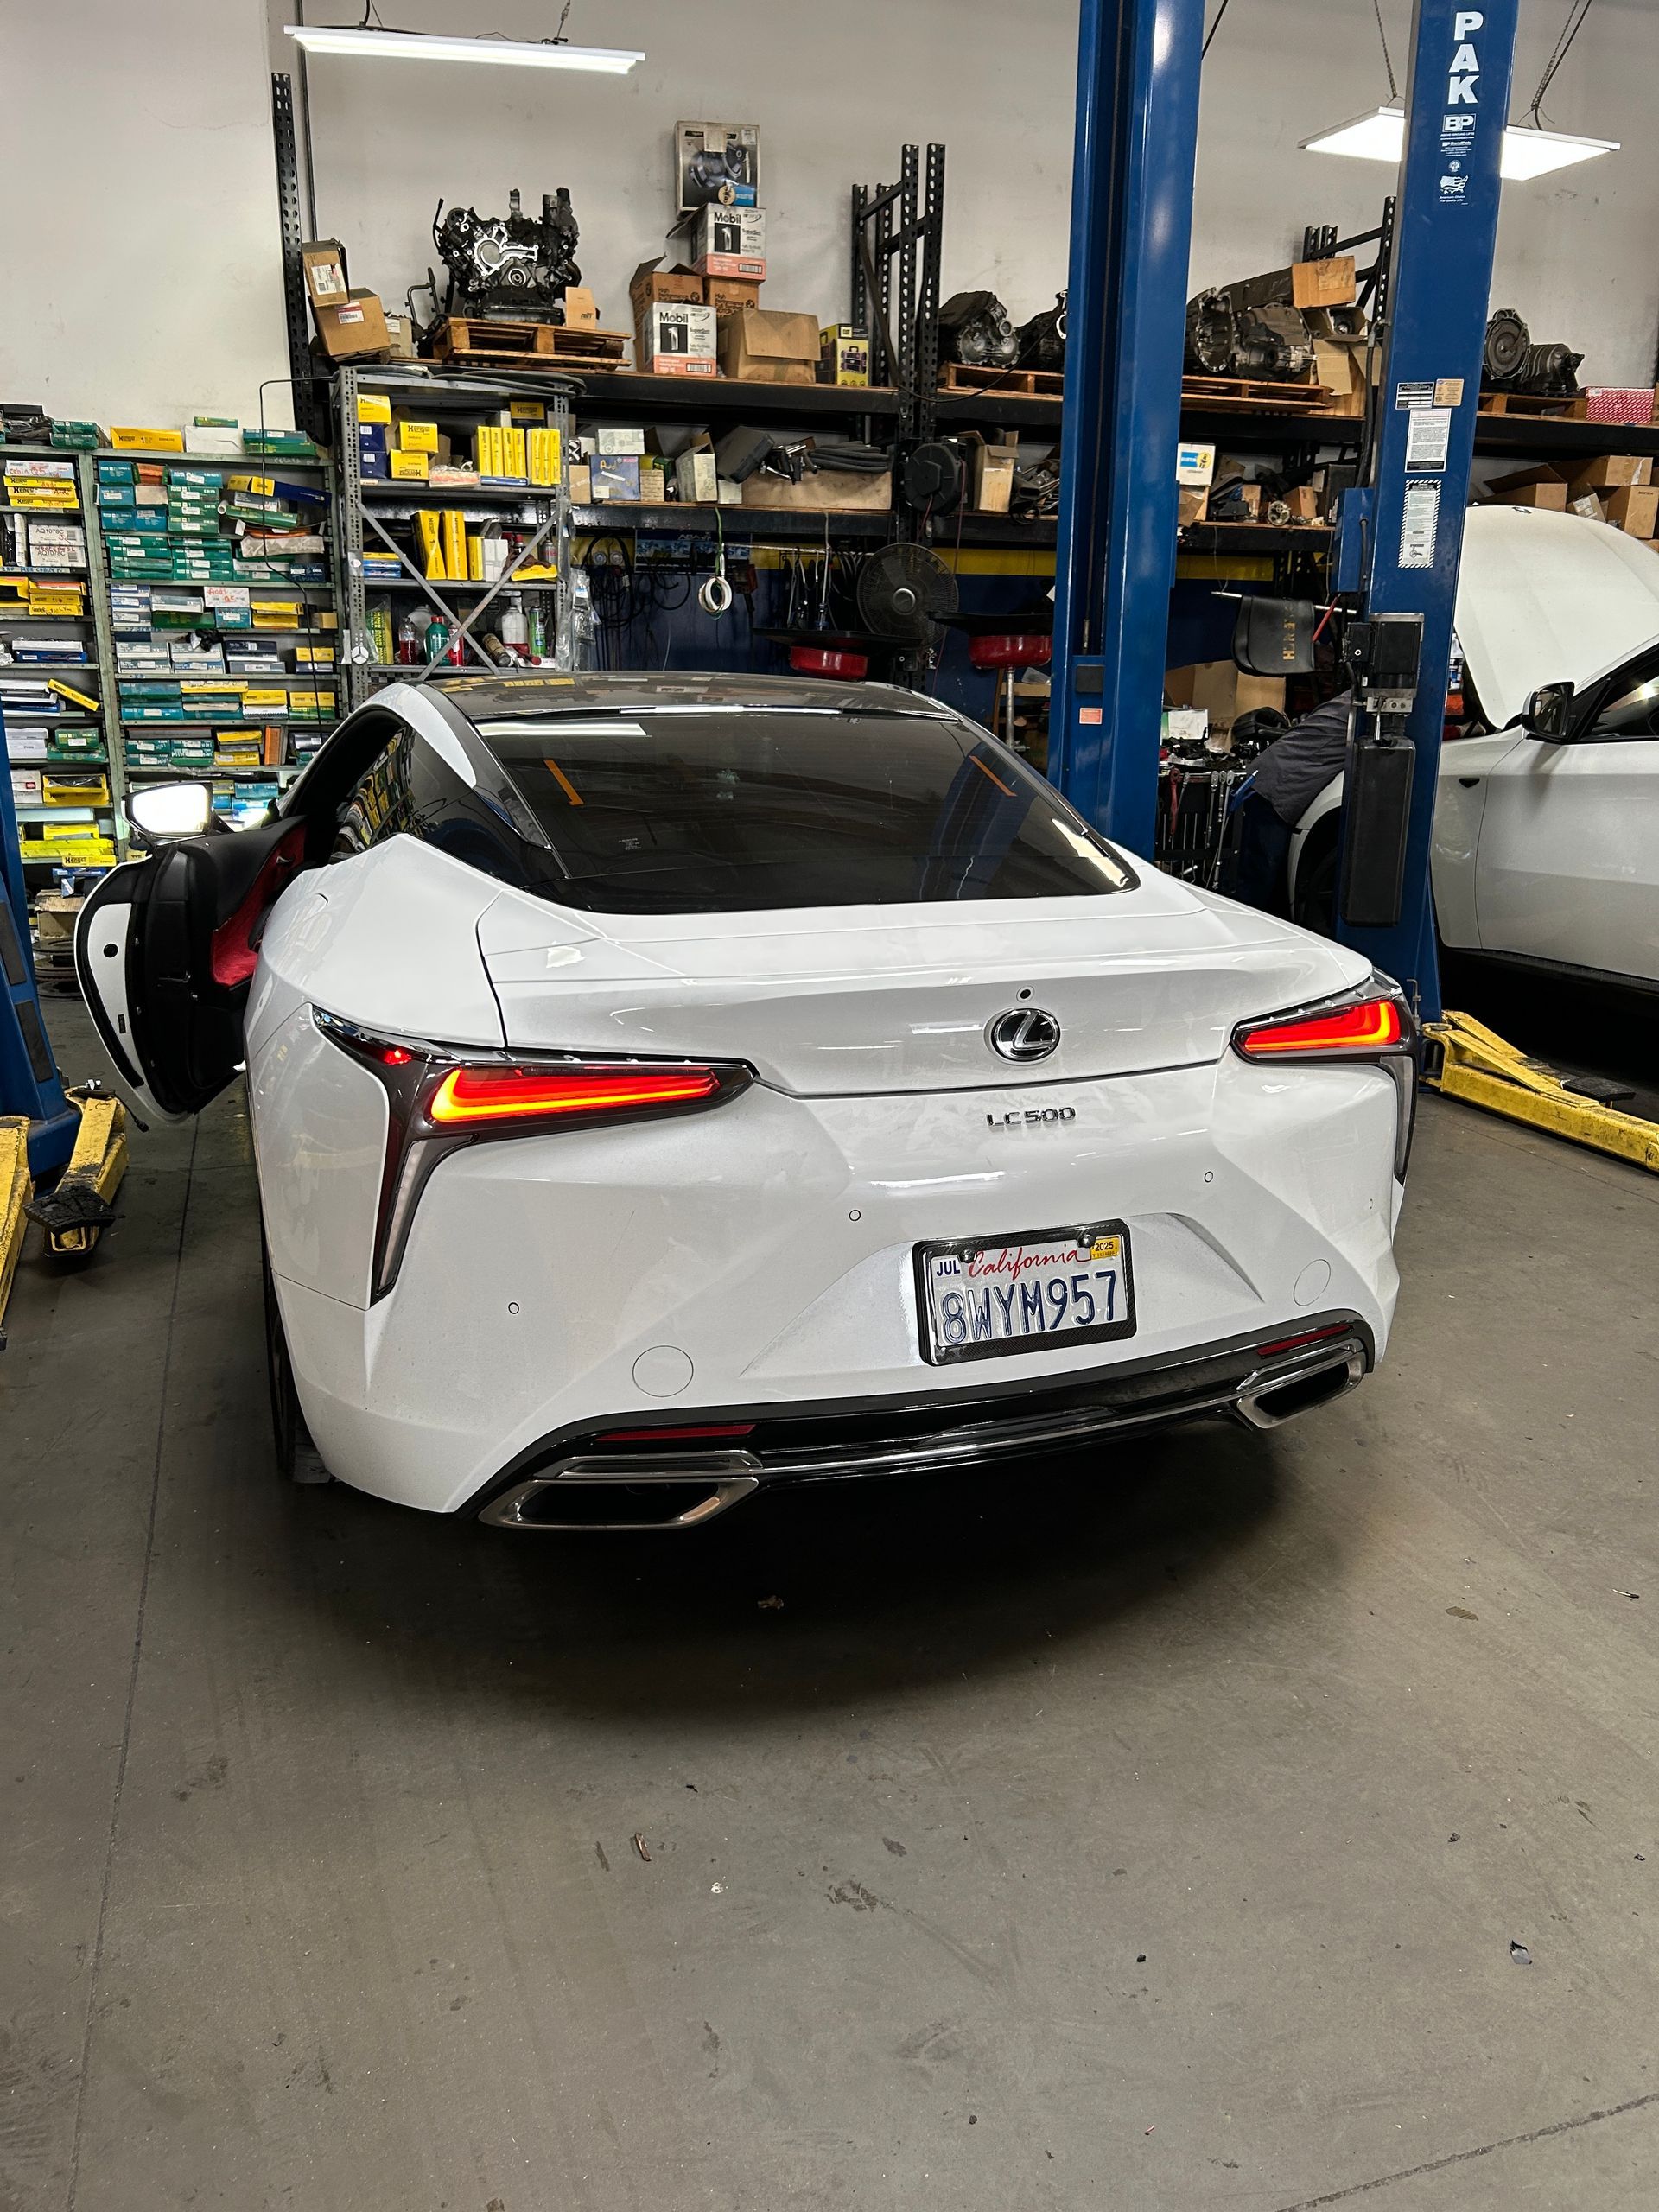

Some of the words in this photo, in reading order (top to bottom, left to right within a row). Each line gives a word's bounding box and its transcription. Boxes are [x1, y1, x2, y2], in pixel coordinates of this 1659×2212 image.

[1447, 11, 1484, 105] PAK
[1444, 115, 1474, 130] BP
[714, 212, 741, 224] Mobil
[659, 312, 689, 323] Mobil
[1095, 1241, 1114, 1252] 2025
[936, 1259, 961, 1277] JUL
[968, 1244, 1092, 1281] California
[941, 1269, 1117, 1344] 8WYM957
